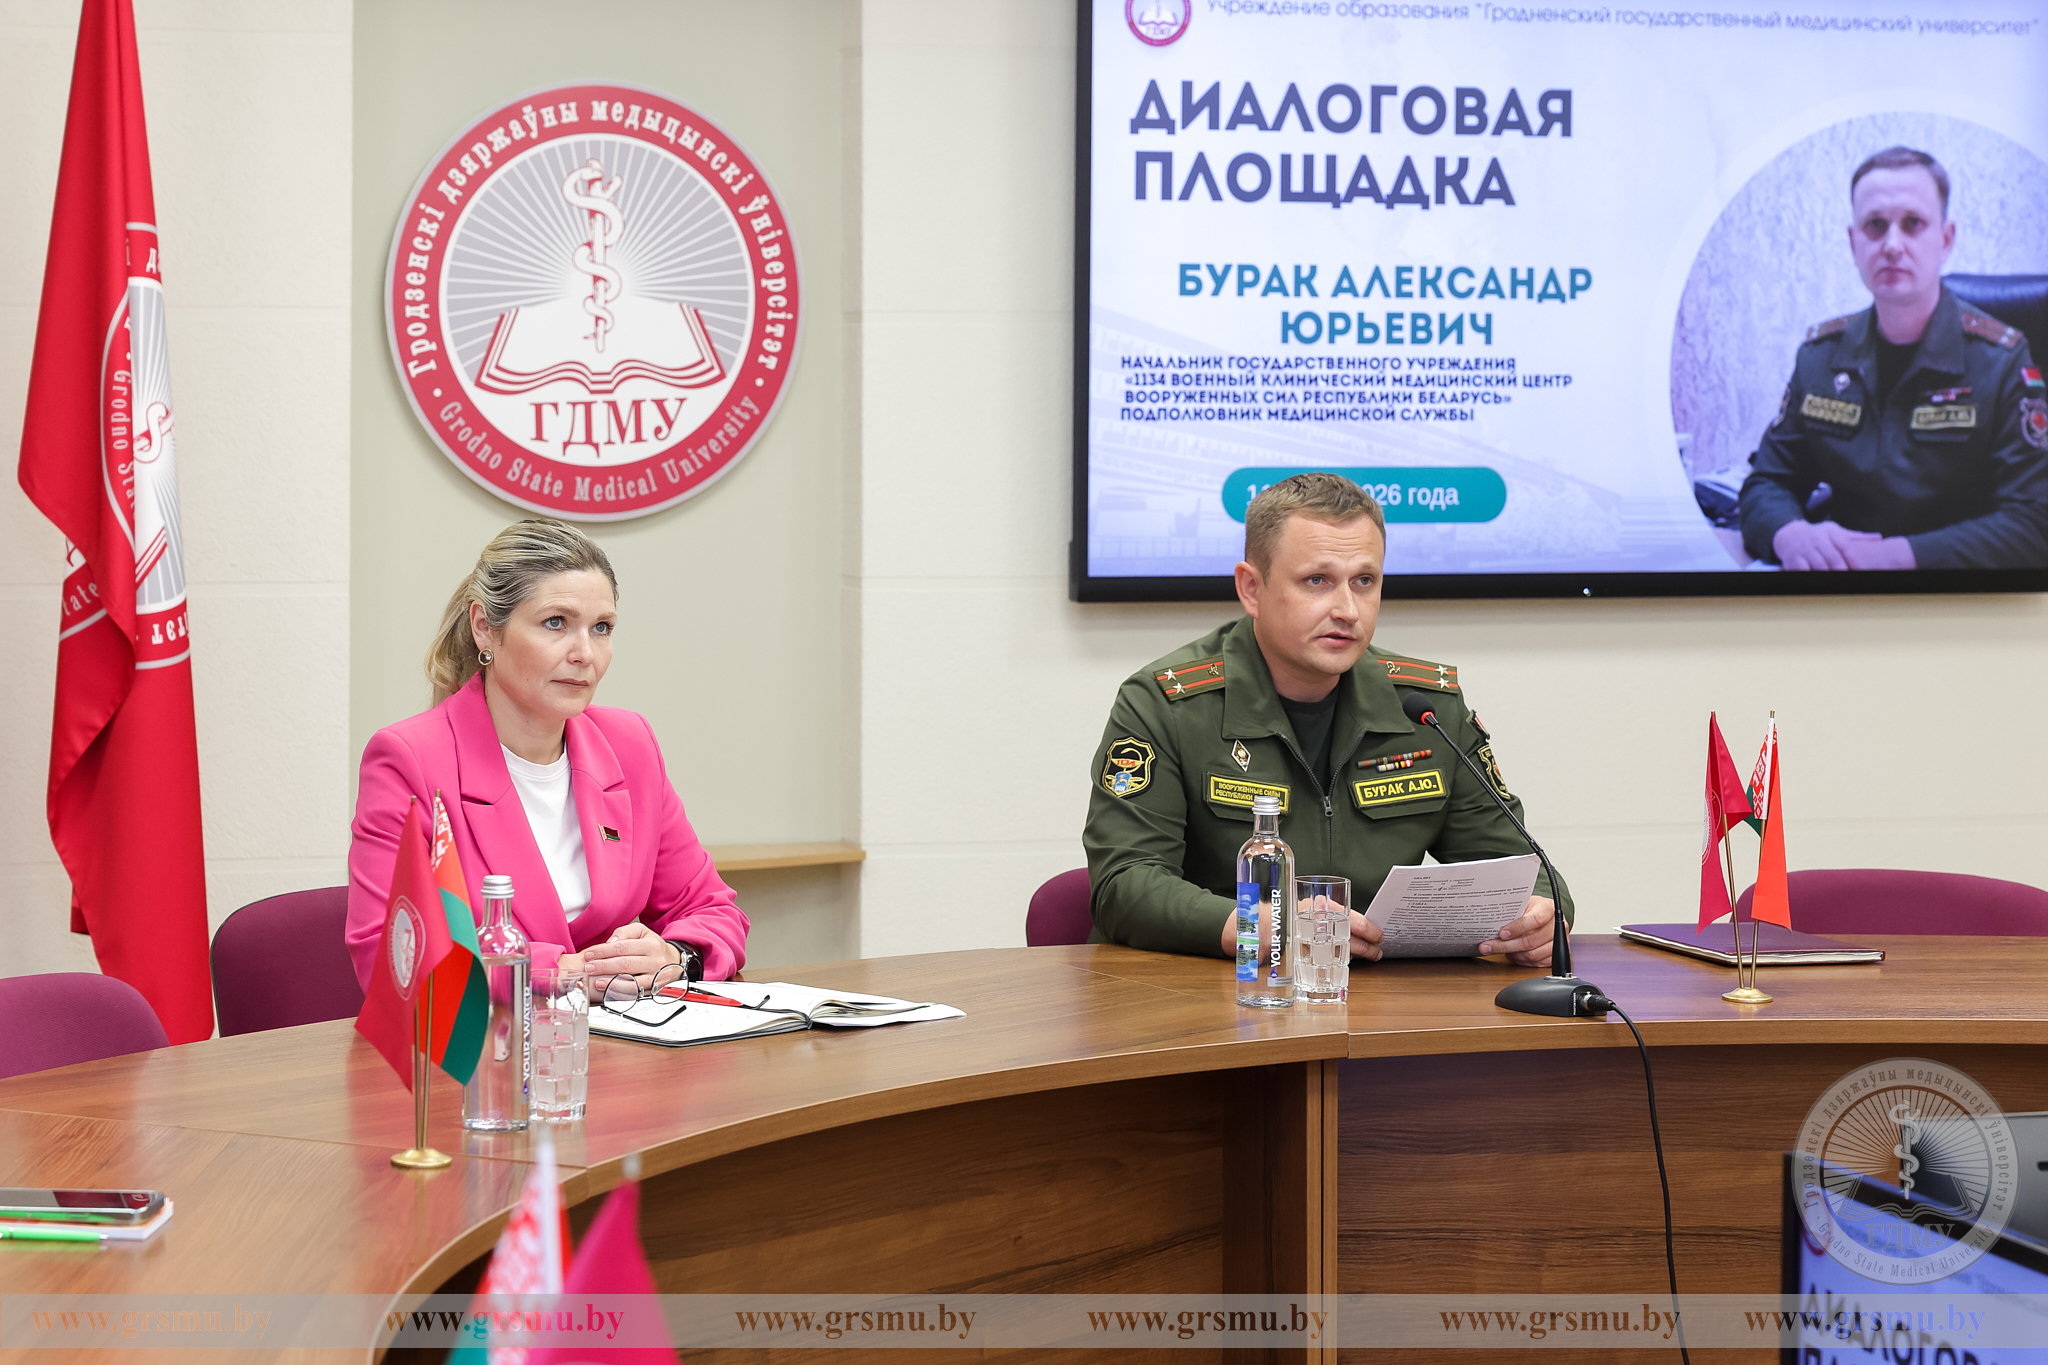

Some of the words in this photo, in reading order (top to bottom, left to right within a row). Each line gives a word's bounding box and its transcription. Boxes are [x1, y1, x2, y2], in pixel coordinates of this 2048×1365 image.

[1336, 1, 1469, 20] образования
[1615, 8, 1781, 29] государственный
[1786, 13, 1912, 32] медицинский
[1130, 79, 1573, 138] ДИАЛОГОВАЯ
[1135, 151, 1517, 210] ПЛОЩАДКА
[405, 203, 444, 378] Гродзенскі
[437, 100, 579, 203] дзяржаўны
[590, 100, 755, 194] медыцынскі
[739, 194, 794, 370] ўніверсітэт
[1178, 263, 1318, 298] БУРАК
[1331, 265, 1593, 303] АЛЕКСАНДР
[1281, 311, 1493, 345] ЮРЬЕВИЧ
[1121, 356, 1222, 369] НАЧАЛЬНИК
[1228, 356, 1401, 371] ГОСУДАРСТВЕННОГО
[1407, 357, 1516, 371] УЧРЕЖДЕНИЯ
[1125, 373, 1166, 386] «1134
[1171, 370, 1256, 386] ВОЕННЫЙ
[1261, 370, 1386, 387] КЛИНИЧЕСКИЙ
[1392, 371, 1517, 388] МЕДИЦИНСКИЙ
[1522, 374, 1573, 389] ЦЕНТР
[1120, 407, 1262, 422] ПОДПОЛКОВНИК
[1267, 405, 1396, 422] МЕДИЦИНСКОЙ
[1401, 408, 1474, 422] СЛУЖБЫ
[1125, 390, 1258, 404] ВООРУЖЕННЫХ
[1263, 391, 1297, 404] СИЛ
[1303, 391, 1413, 404] РЕСПУБЛИКИ
[1418, 391, 1513, 405] БЕЛАРУСЬ»
[530, 397, 688, 458] ГДМУ
[439, 400, 499, 470] Grodno
[505, 458, 563, 498] State
[573, 469, 658, 501] Medical
[661, 394, 761, 485] University
[1408, 487, 1459, 511] года
[1215, 789, 1253, 801] РЕСПУБЛИКИ
[1218, 782, 1263, 796] ВООРУЖЕННЫЕ
[1264, 788, 1281, 798] СИЛЫ
[1364, 783, 1404, 799] БУРАК
[1408, 777, 1438, 793] А.Ю.
[1271, 888, 1282, 931] WATER
[1271, 934, 1282, 968] YOUR
[523, 1041, 531, 1081] YOUR
